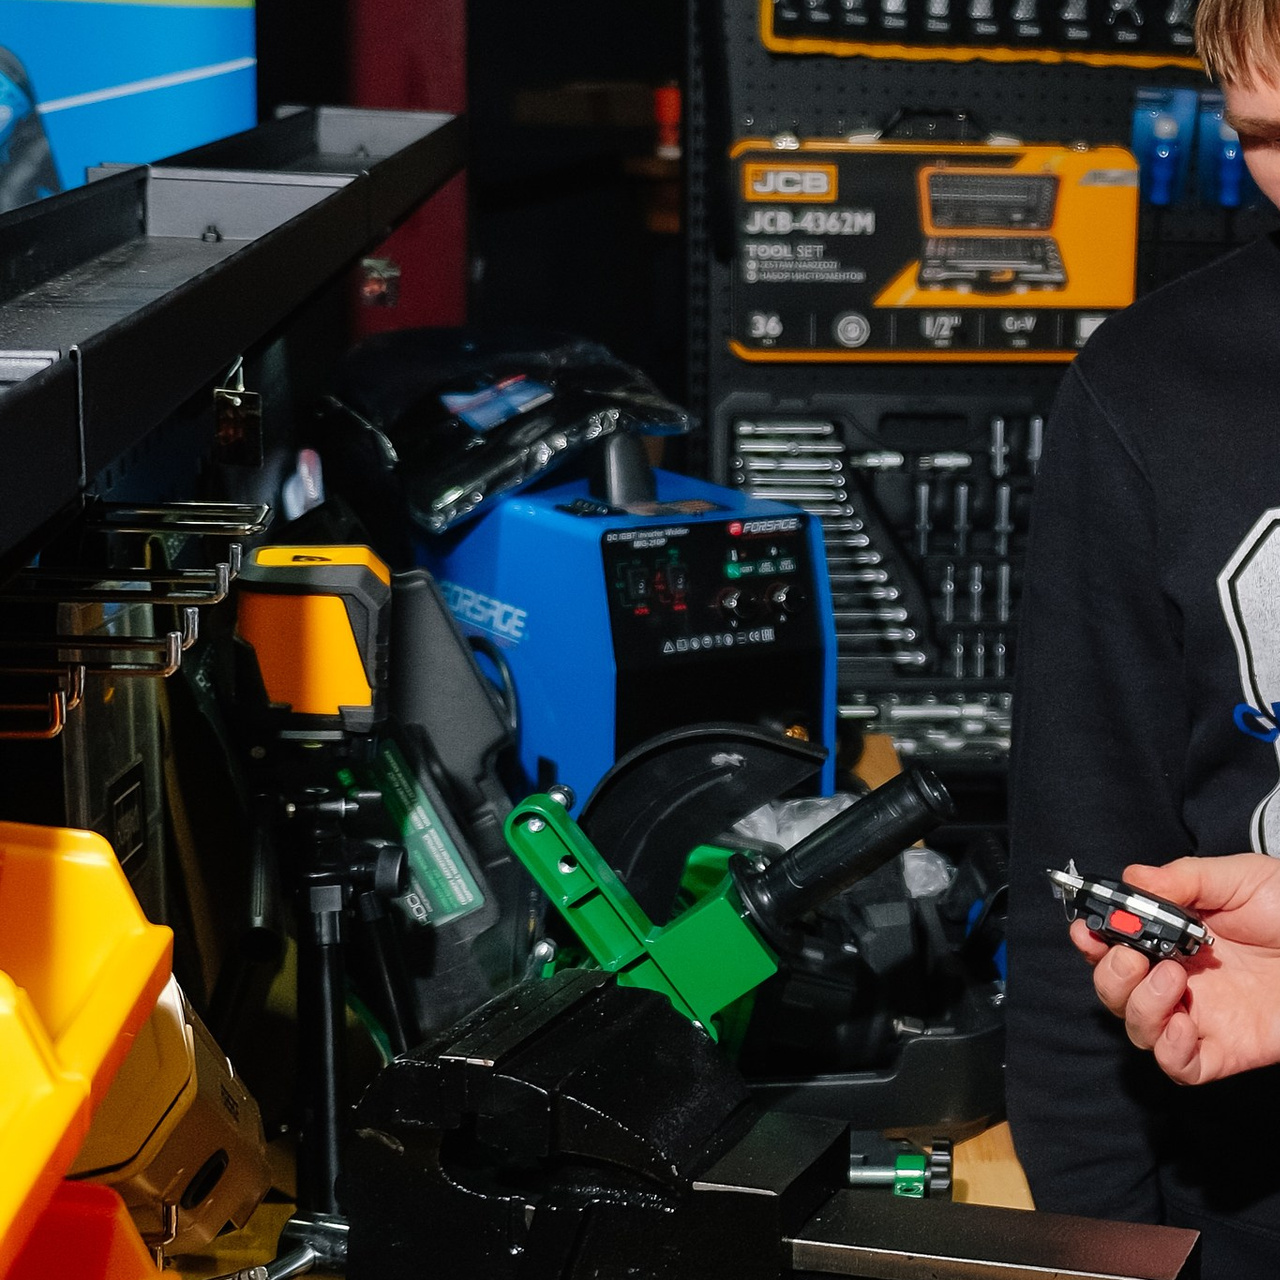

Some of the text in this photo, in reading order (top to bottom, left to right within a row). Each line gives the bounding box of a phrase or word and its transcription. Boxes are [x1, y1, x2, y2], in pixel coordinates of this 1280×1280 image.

[753, 171, 829, 193] JCB
[746, 211, 876, 235] JCB-4362M
[745, 244, 825, 259] TOOL SET
[752, 315, 783, 338] 36
[1005, 316, 1037, 333] Cr-V
[743, 519, 798, 533] FORSAGE
